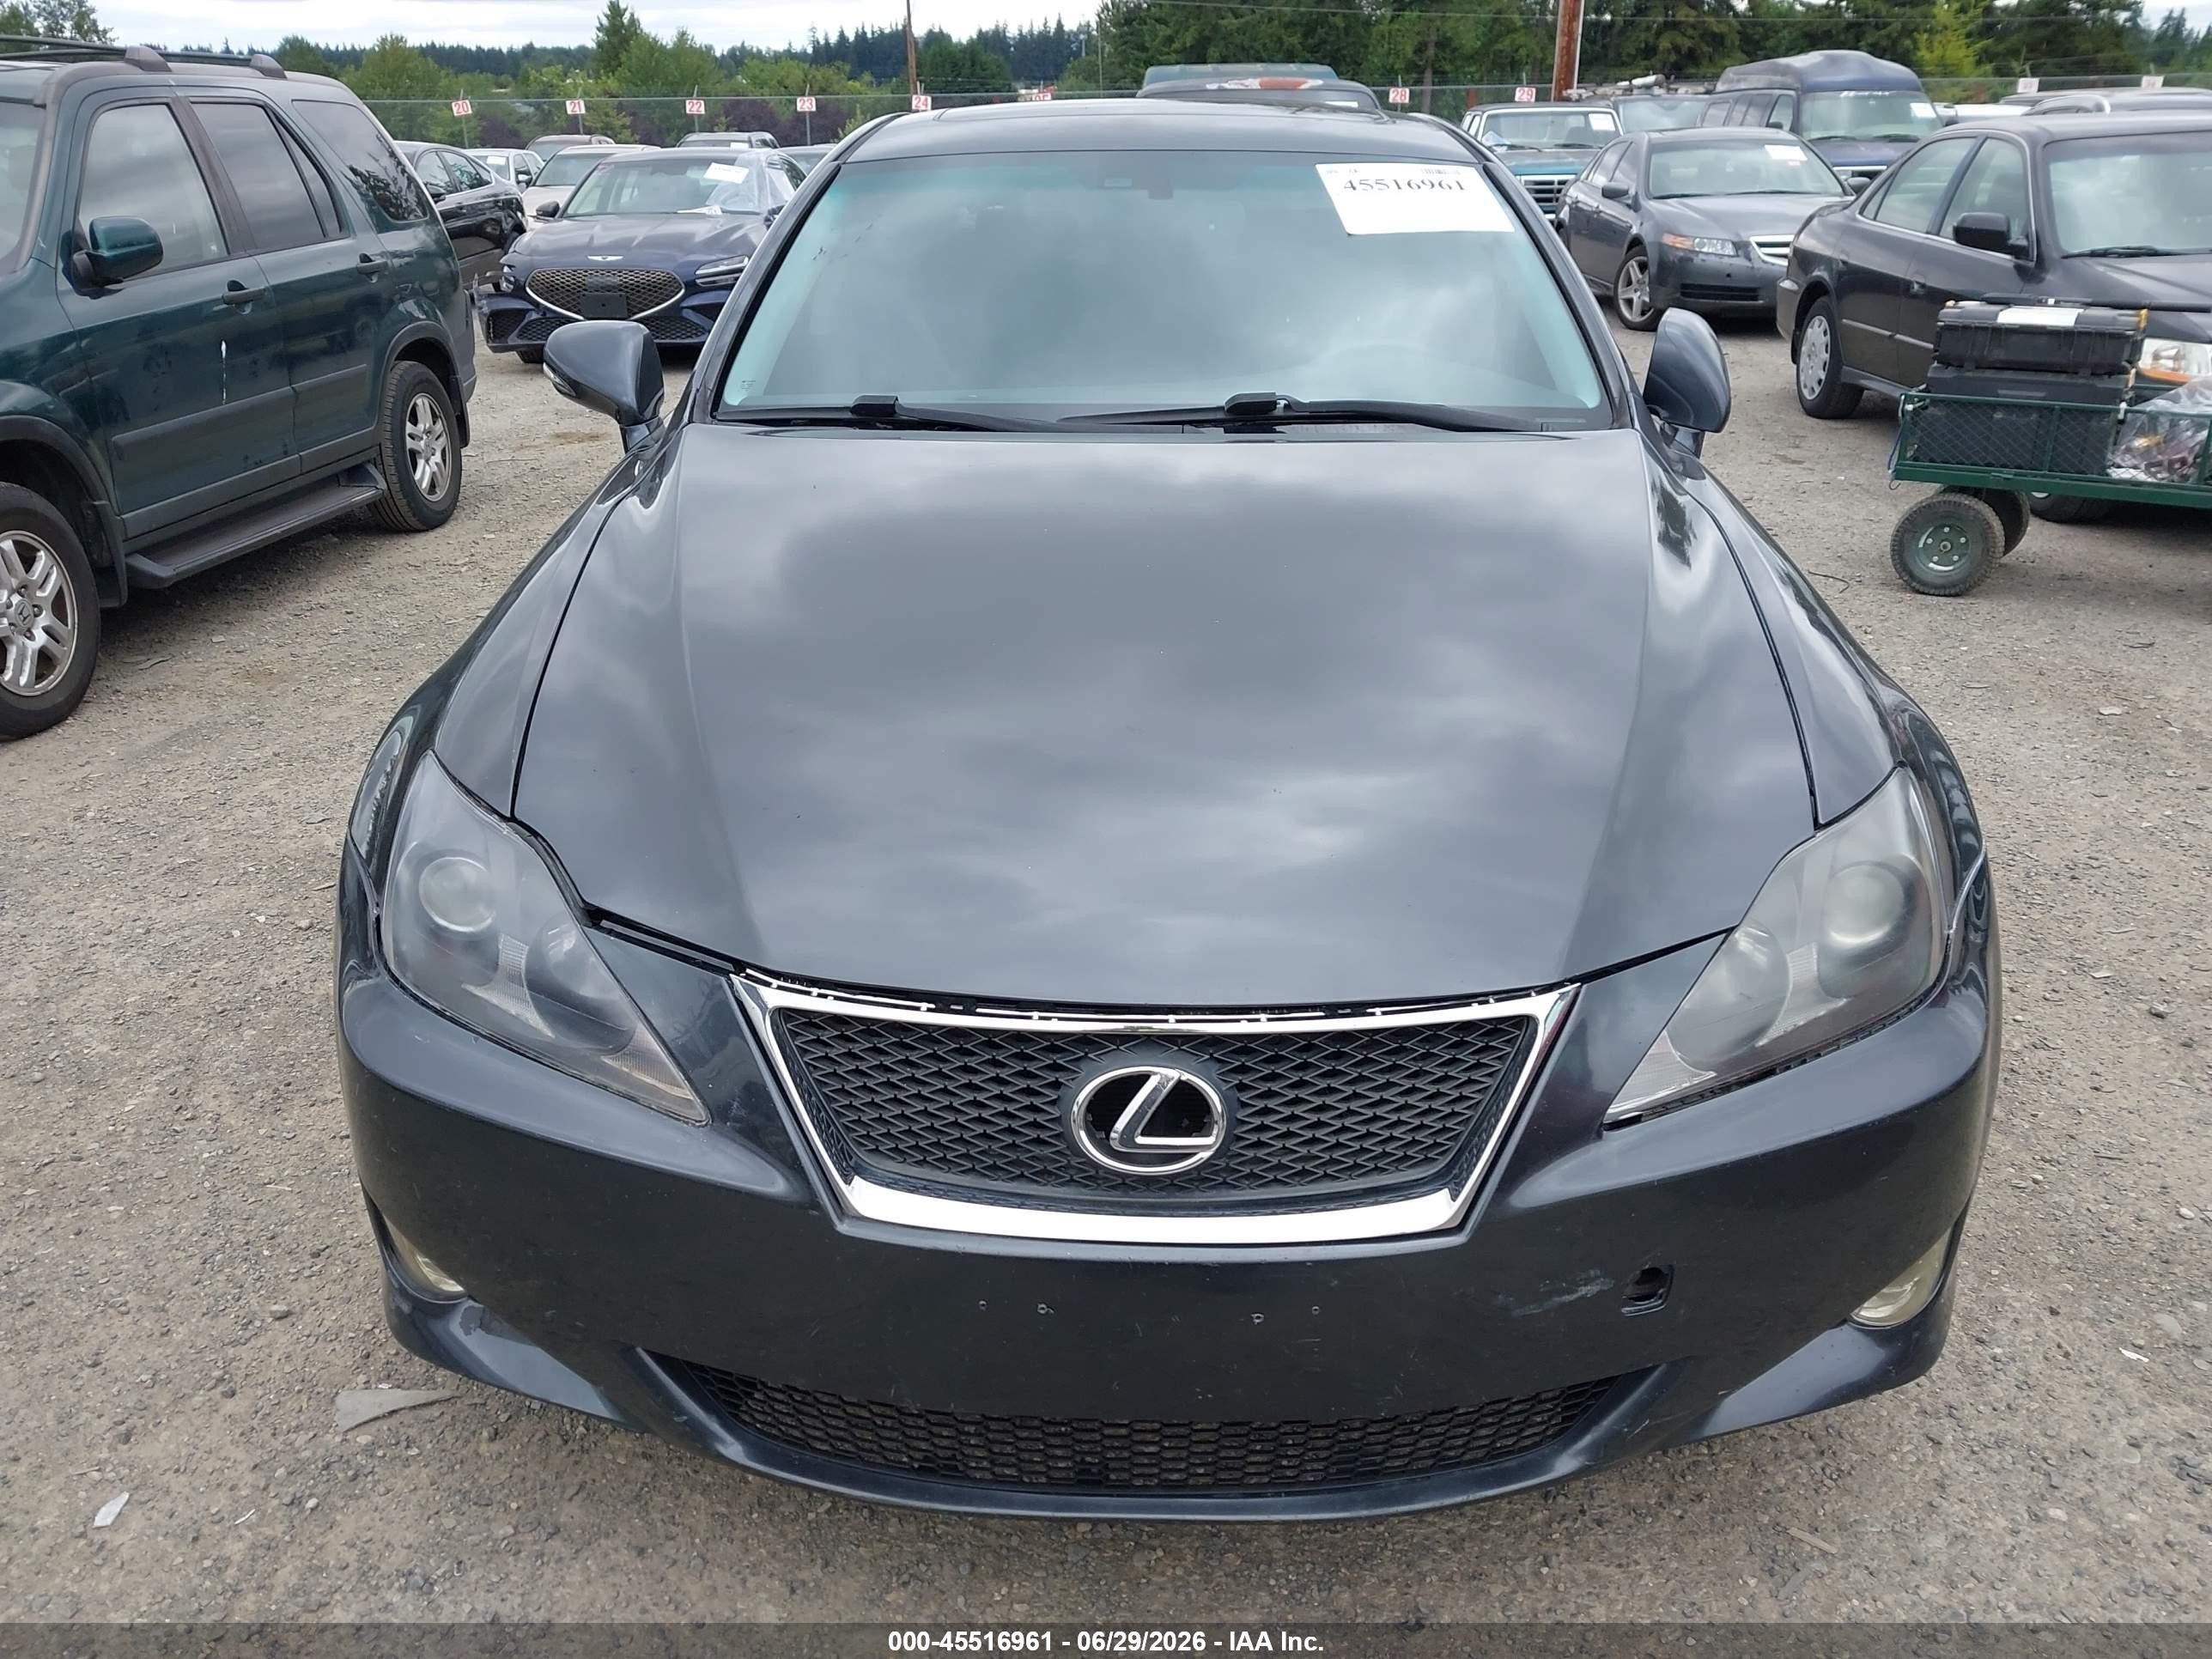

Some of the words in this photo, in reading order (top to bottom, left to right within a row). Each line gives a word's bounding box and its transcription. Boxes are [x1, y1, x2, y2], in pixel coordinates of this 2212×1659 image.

[1392, 88, 1407, 100] 28
[1518, 88, 1534, 100] 29
[453, 100, 469, 114] 20
[569, 100, 583, 113] 21
[687, 100, 702, 113] 22
[799, 97, 813, 111] 23
[915, 96, 930, 108] 24
[1343, 178, 1467, 191] 45516961
